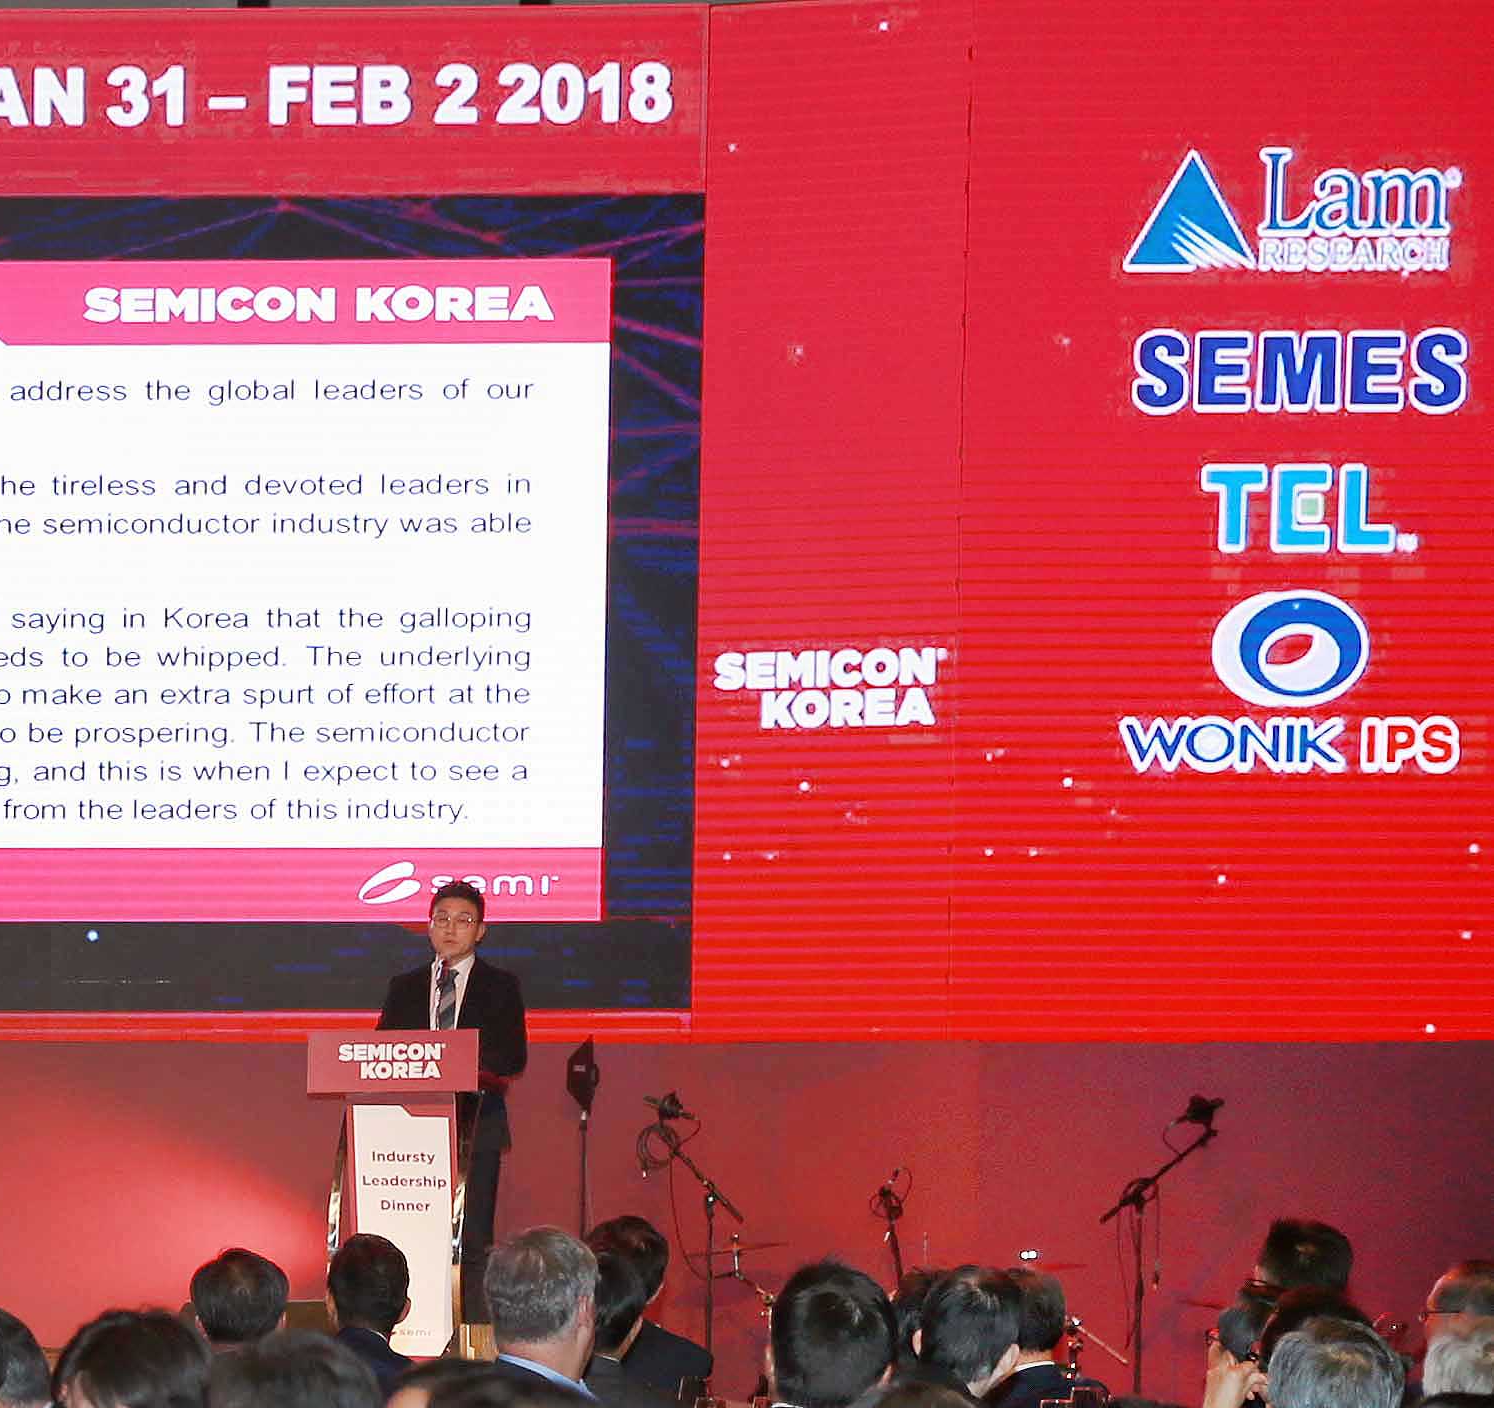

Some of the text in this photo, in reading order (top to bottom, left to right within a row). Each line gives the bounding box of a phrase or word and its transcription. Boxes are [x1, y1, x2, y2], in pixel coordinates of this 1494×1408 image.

[105, 65, 185, 127] 31
[268, 65, 412, 126] FEB
[433, 63, 479, 125] 2
[495, 62, 673, 125] 2018
[1258, 147, 1451, 237] Lam
[1258, 236, 1451, 271] RESEARCH
[83, 285, 554, 323] SEMICON KOREA
[1131, 327, 1468, 415] SEMES
[10, 379, 128, 402] address
[145, 379, 191, 401] the
[208, 378, 295, 407] global
[315, 378, 424, 401] leaders
[442, 377, 471, 401] of
[486, 383, 535, 400] our
[51, 473, 156, 497] tireless
[174, 474, 227, 496] and
[244, 473, 363, 496] devoted
[381, 473, 489, 496] leaders
[507, 473, 531, 495] in
[42, 512, 260, 535] semiconductor
[272, 512, 389, 540] industry
[399, 516, 458, 534] was
[470, 511, 532, 534] able
[11, 607, 105, 635] saying
[123, 607, 145, 629] in
[164, 607, 249, 630] Korea
[266, 607, 321, 629] that
[338, 607, 384, 629] the
[399, 607, 531, 634] galloping
[61, 647, 89, 668] to
[106, 645, 142, 668] be
[156, 645, 287, 673] whipped.
[305, 645, 362, 668] The
[380, 645, 531, 672] underlying
[22, 683, 102, 706] make
[114, 687, 148, 705] an
[160, 684, 231, 705] extra
[242, 684, 314, 710] spurt
[327, 683, 355, 705] of
[364, 682, 436, 705] effort
[448, 684, 474, 705] at
[484, 682, 531, 705] the
[761, 687, 936, 729] KOREA
[28, 722, 64, 744] be
[74, 721, 235, 749] prospering.
[248, 721, 305, 743] The
[316, 721, 530, 744] semiconductor
[1118, 716, 1461, 774] WONIK IPS
[33, 759, 86, 782] and
[98, 760, 148, 782] this
[160, 759, 182, 782] is
[192, 759, 270, 782] when
[303, 761, 399, 787] expect
[410, 761, 437, 782] to
[448, 764, 500, 781] see
[511, 764, 528, 781] a
[2, 798, 66, 820] from
[77, 799, 124, 821] the
[133, 798, 238, 821] leaders
[250, 797, 278, 820] of
[287, 799, 338, 820] this
[347, 798, 468, 825] industry.
[360, 1062, 442, 1080] KOREA
[371, 1151, 436, 1165] Indursty
[362, 1175, 448, 1189] Leadership
[380, 1199, 431, 1212] Dinner
